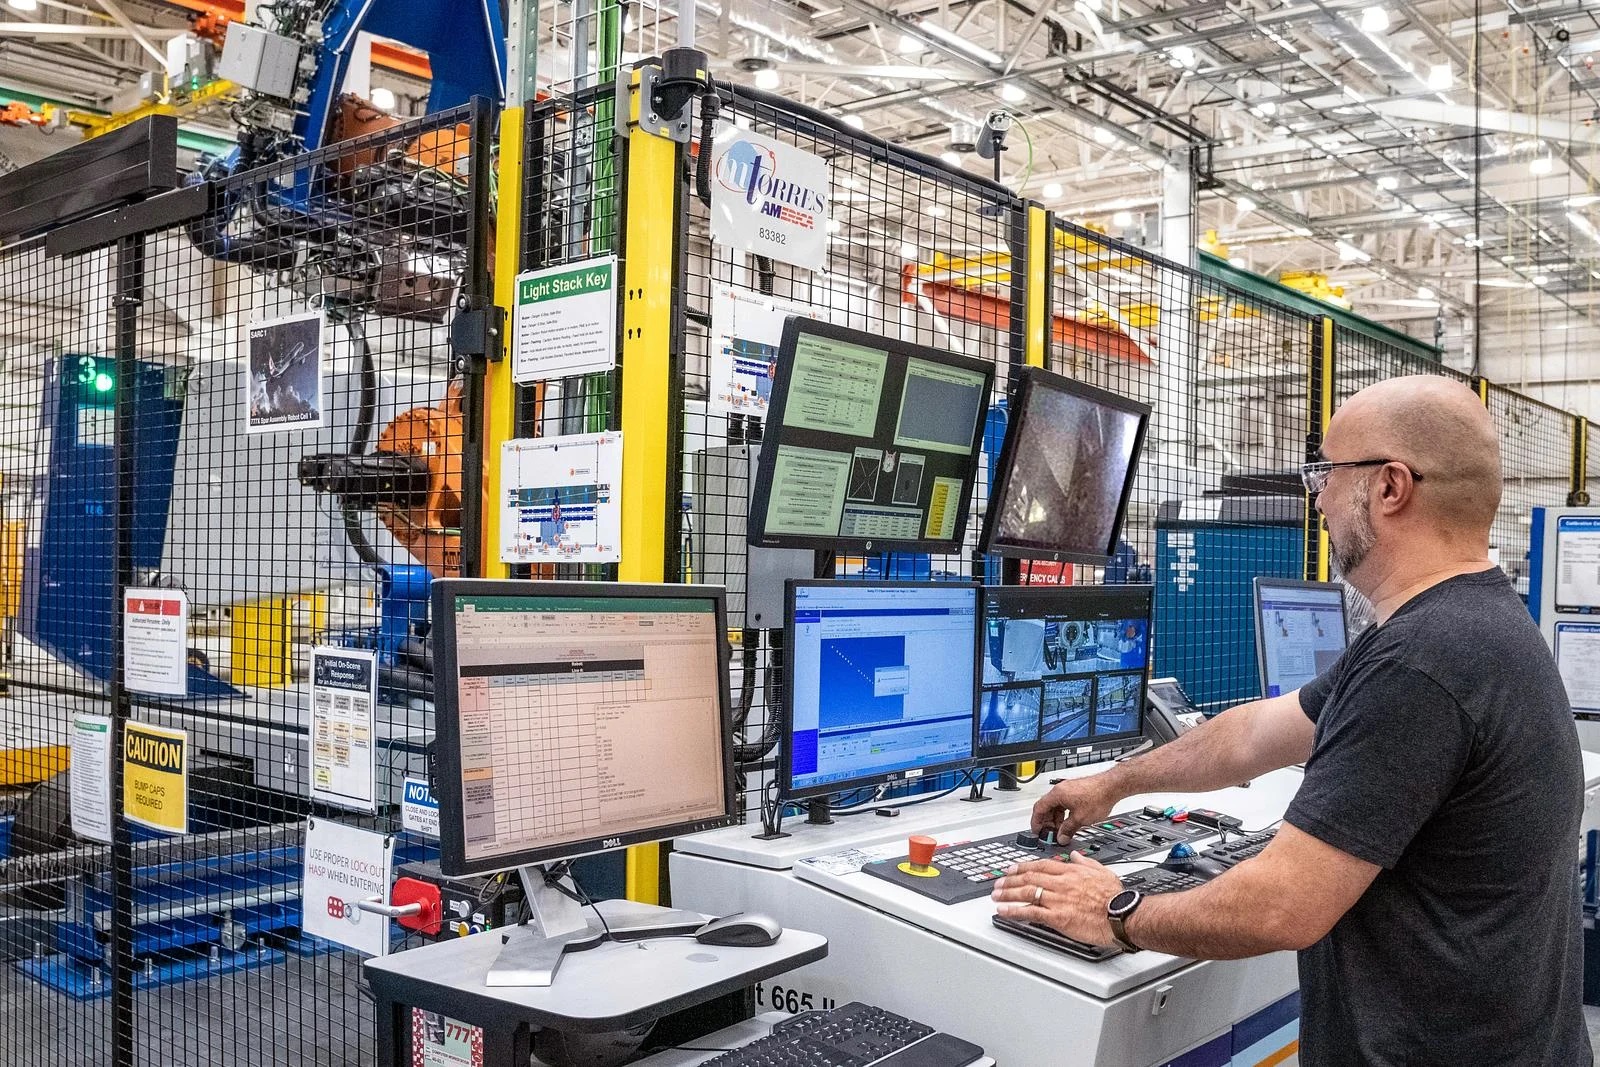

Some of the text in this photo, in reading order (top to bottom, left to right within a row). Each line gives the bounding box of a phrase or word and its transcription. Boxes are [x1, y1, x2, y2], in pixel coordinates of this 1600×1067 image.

[759, 227, 786, 245] 83382
[523, 272, 608, 300] Light Stack Key
[250, 330, 264, 339] SARC
[78, 356, 97, 383] 3
[261, 416, 270, 425] Spar
[270, 415, 287, 424] Assembly
[288, 413, 300, 421] Robot
[300, 412, 309, 420] Cell
[161, 618, 171, 627] Only
[325, 659, 361, 671] Initial On-Scene
[331, 670, 355, 680] Response
[330, 680, 352, 688] Automation
[352, 682, 367, 690] Incident
[126, 734, 181, 769] CAUTION
[134, 779, 165, 797] BUMP CAPS
[136, 793, 163, 810] REQUIRED
[405, 805, 419, 814] CLOSE
[419, 808, 428, 816] AND
[408, 814, 422, 823] GATES
[428, 818, 438, 826] END
[420, 825, 433, 833] SHIFT
[602, 837, 622, 849] DELL
[309, 847, 385, 879] USE PROPER LOCK OUT
[308, 863, 385, 896] HASP WHEN ENTERING
[446, 1023, 471, 1044] 777
